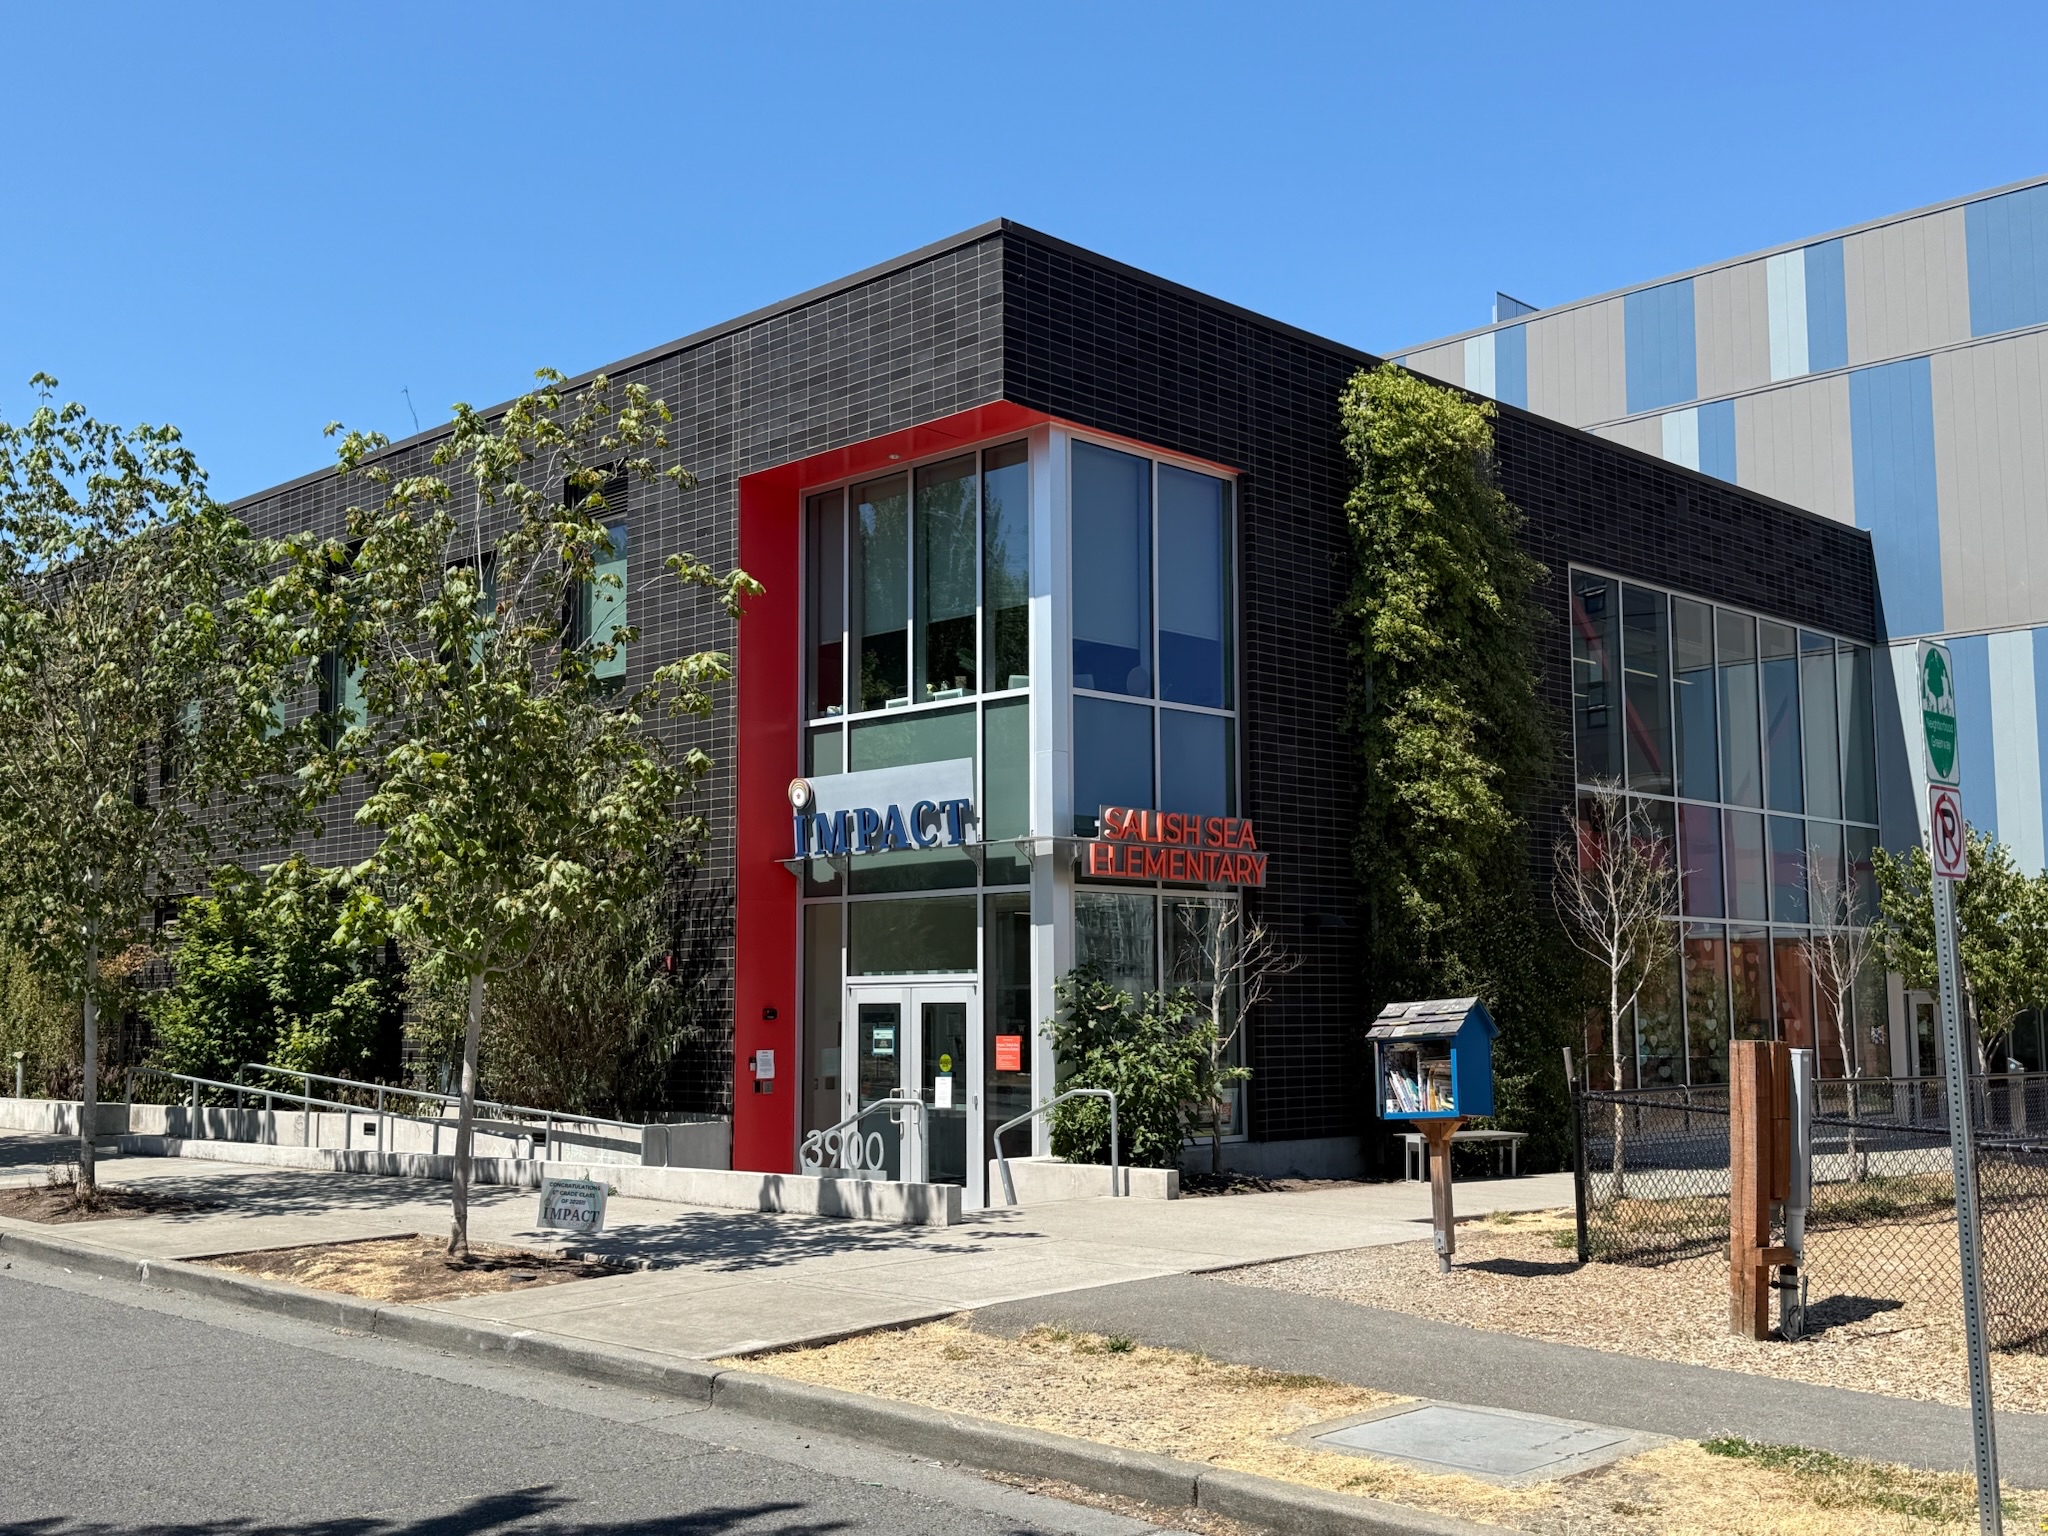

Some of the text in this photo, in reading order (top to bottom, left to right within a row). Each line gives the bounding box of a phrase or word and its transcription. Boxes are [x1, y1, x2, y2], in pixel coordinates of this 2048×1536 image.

[792, 798, 972, 858] IMPACT
[1103, 807, 1257, 851] SALISH SEA
[1089, 842, 1268, 886] ELEMENTARY
[806, 1129, 884, 1171] 3900
[549, 1182, 601, 1191] CONGRATULATIONS
[543, 1206, 600, 1223] IMPACT
